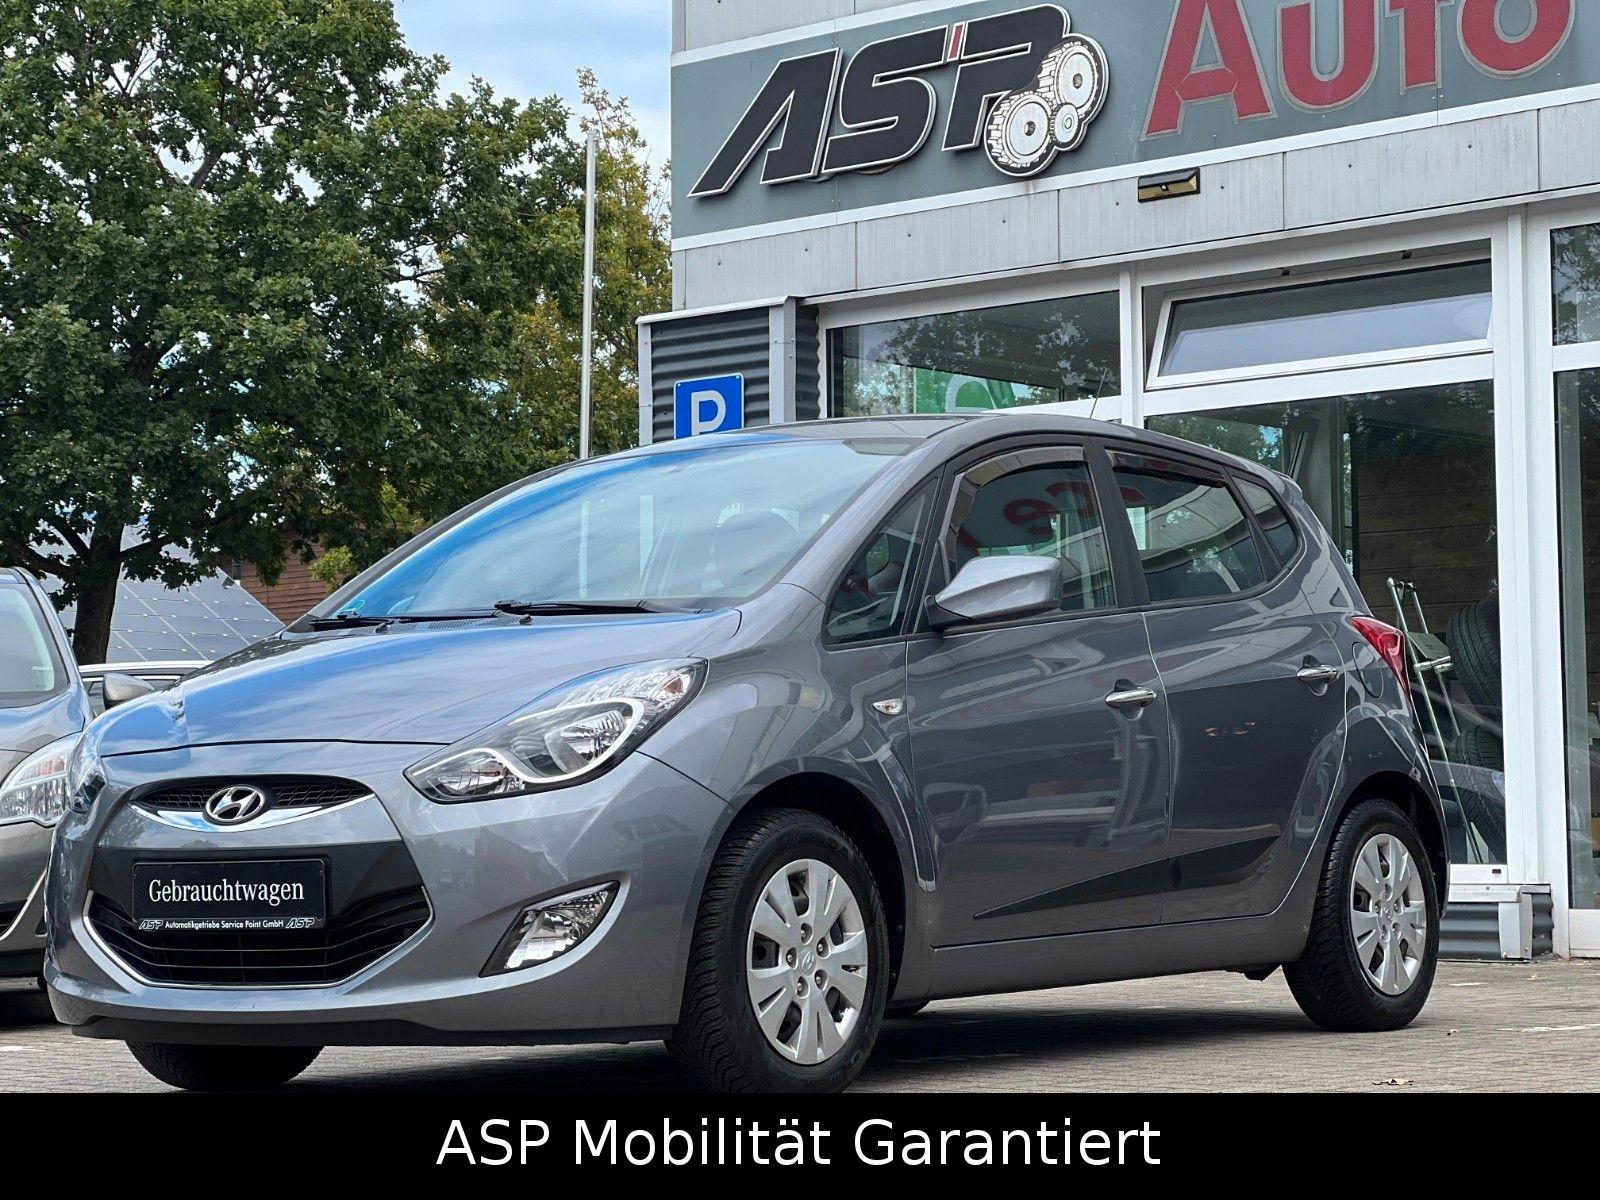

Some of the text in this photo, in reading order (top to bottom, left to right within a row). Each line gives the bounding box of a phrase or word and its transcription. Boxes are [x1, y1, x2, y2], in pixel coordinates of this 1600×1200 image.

[687, 3, 1072, 197] ASP
[691, 390, 727, 436] P
[149, 879, 304, 906] Gebrauchtwagen
[138, 917, 315, 930] ASP Automatikgetriebe Service Point GmbH ASP
